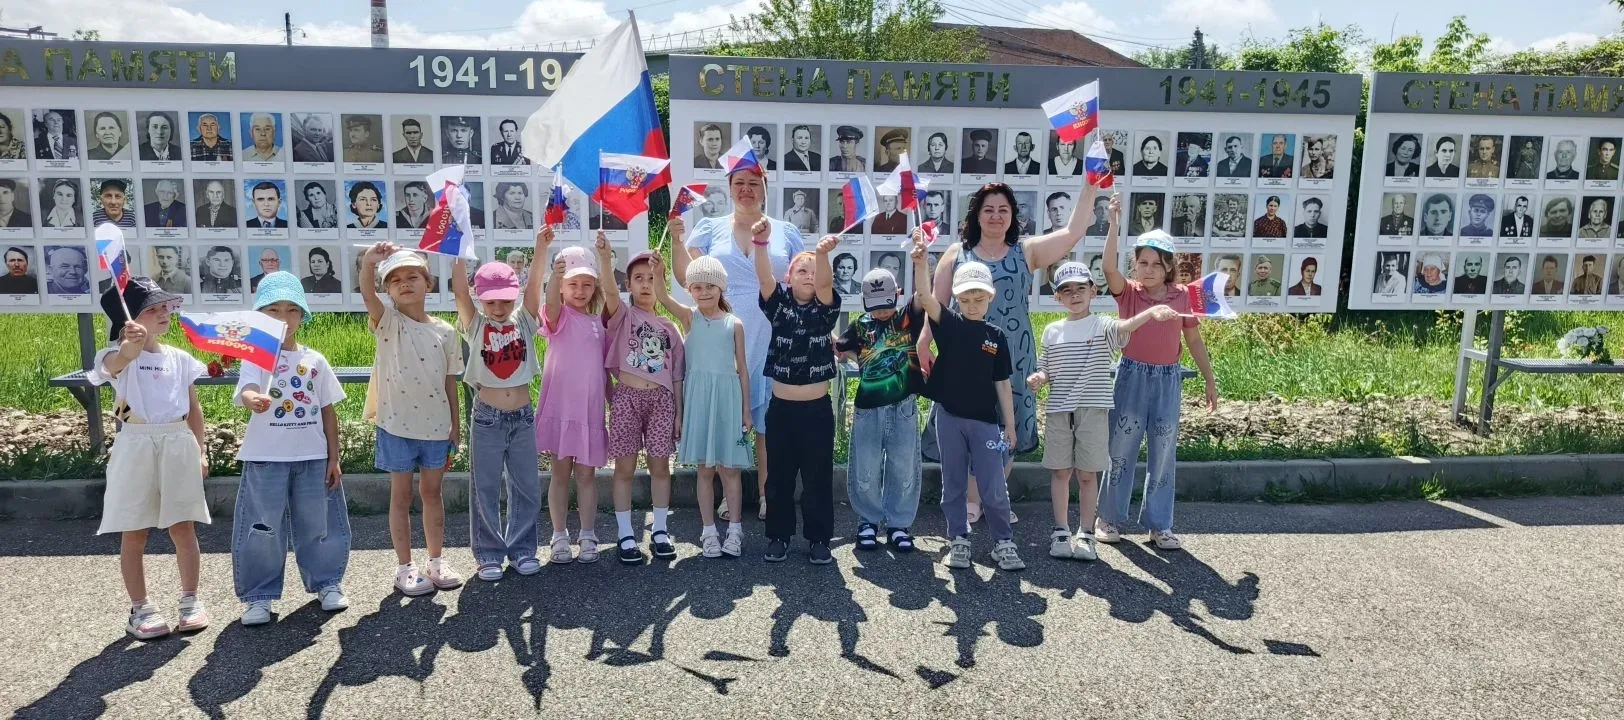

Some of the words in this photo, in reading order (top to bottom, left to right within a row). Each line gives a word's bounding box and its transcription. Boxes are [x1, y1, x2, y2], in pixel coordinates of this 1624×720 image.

[44, 47, 237, 84] ПАМЯТИ
[409, 55, 580, 91] 1941-19
[698, 63, 833, 98] СТЕНА
[847, 68, 1010, 102] ПАМЯТИ
[1159, 75, 1331, 109] 1941-1945
[1402, 79, 1520, 111] СТЕНА
